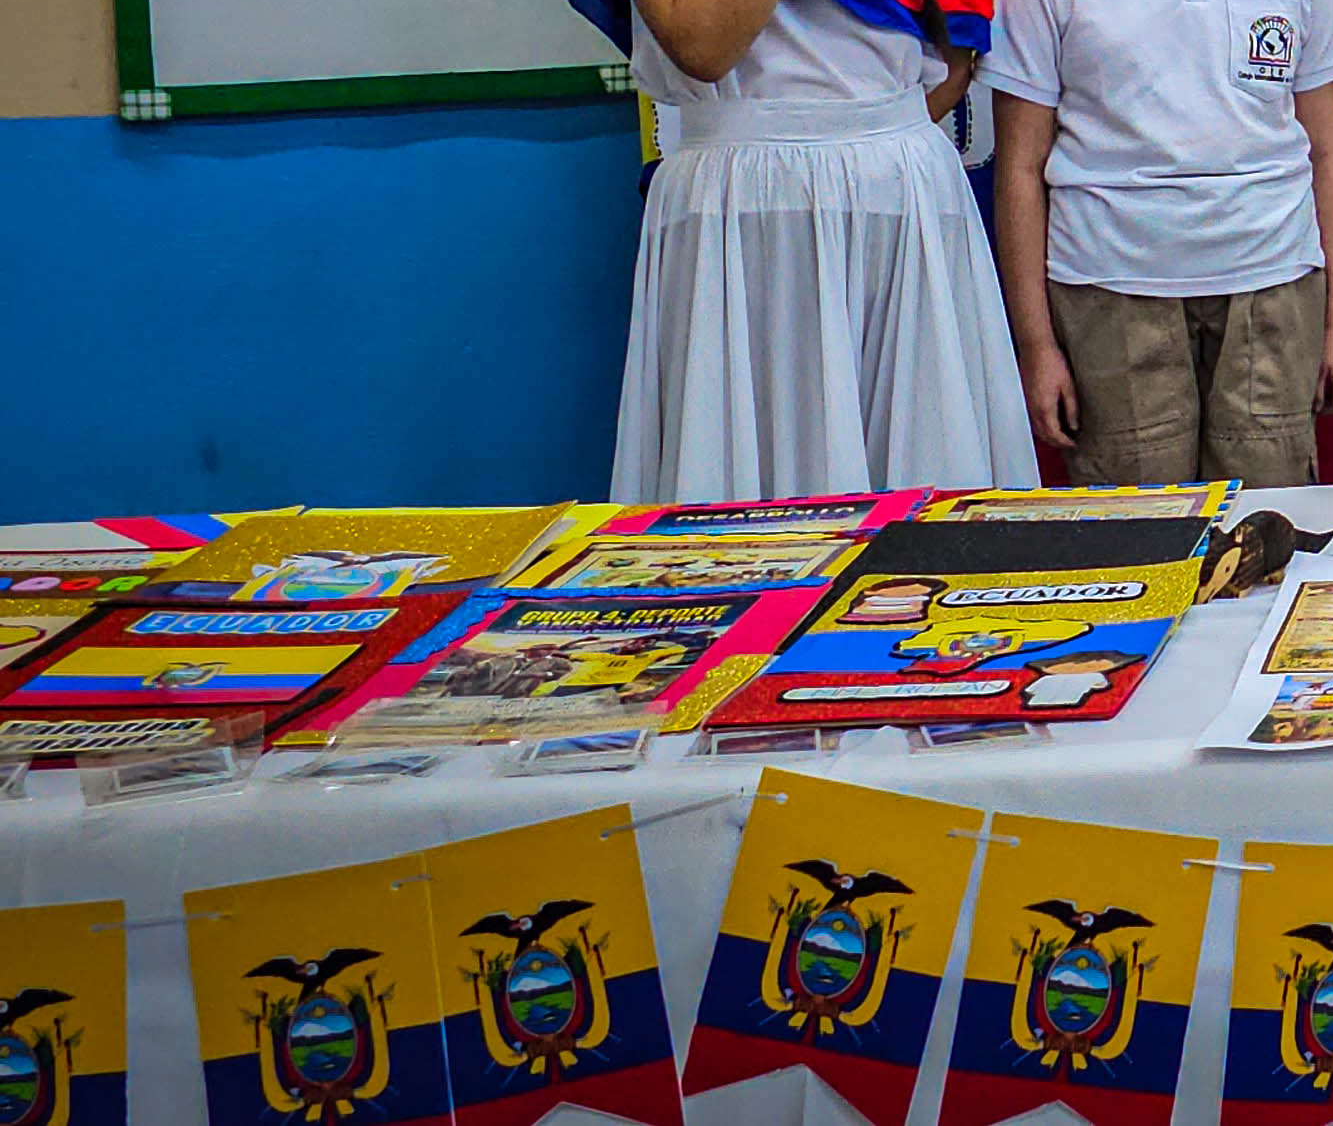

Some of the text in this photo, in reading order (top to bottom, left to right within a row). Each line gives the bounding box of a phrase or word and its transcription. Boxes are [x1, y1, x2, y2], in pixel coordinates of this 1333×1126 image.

[955, 585, 1130, 602] ECUADOR
[147, 613, 387, 629] ECUADOR
[520, 610, 601, 623] GRUPO
